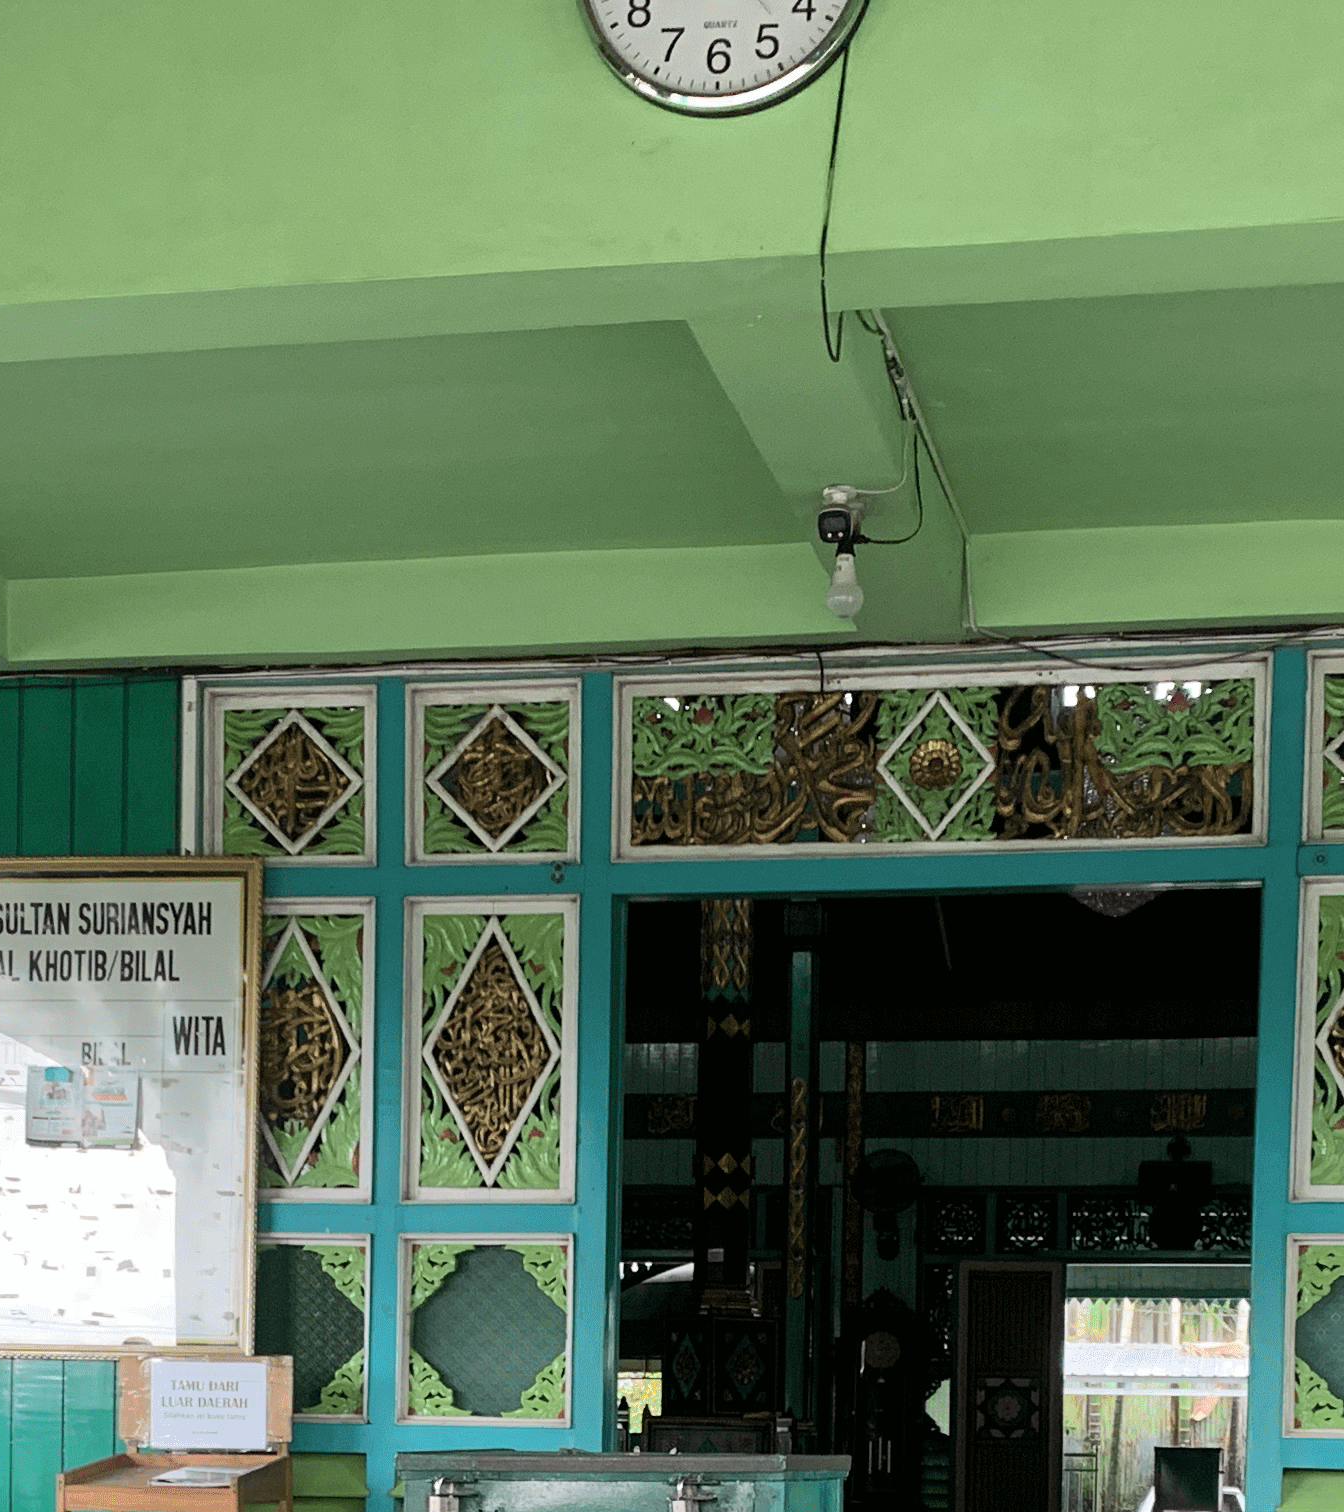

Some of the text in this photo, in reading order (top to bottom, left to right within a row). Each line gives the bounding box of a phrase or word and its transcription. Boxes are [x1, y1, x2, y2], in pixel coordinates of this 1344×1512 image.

[626, 0, 651, 27] 8
[660, 27, 685, 62] 7
[706, 38, 731, 74] 6
[755, 24, 779, 59] 5
[78, 902, 212, 935] SURIANSYAH
[29, 950, 180, 982] KHOTIB/BILAL
[172, 1015, 226, 1056] WITA
[162, 1396, 248, 1408] LUAR DAERAH
[170, 1380, 239, 1392] TAMU DARI
